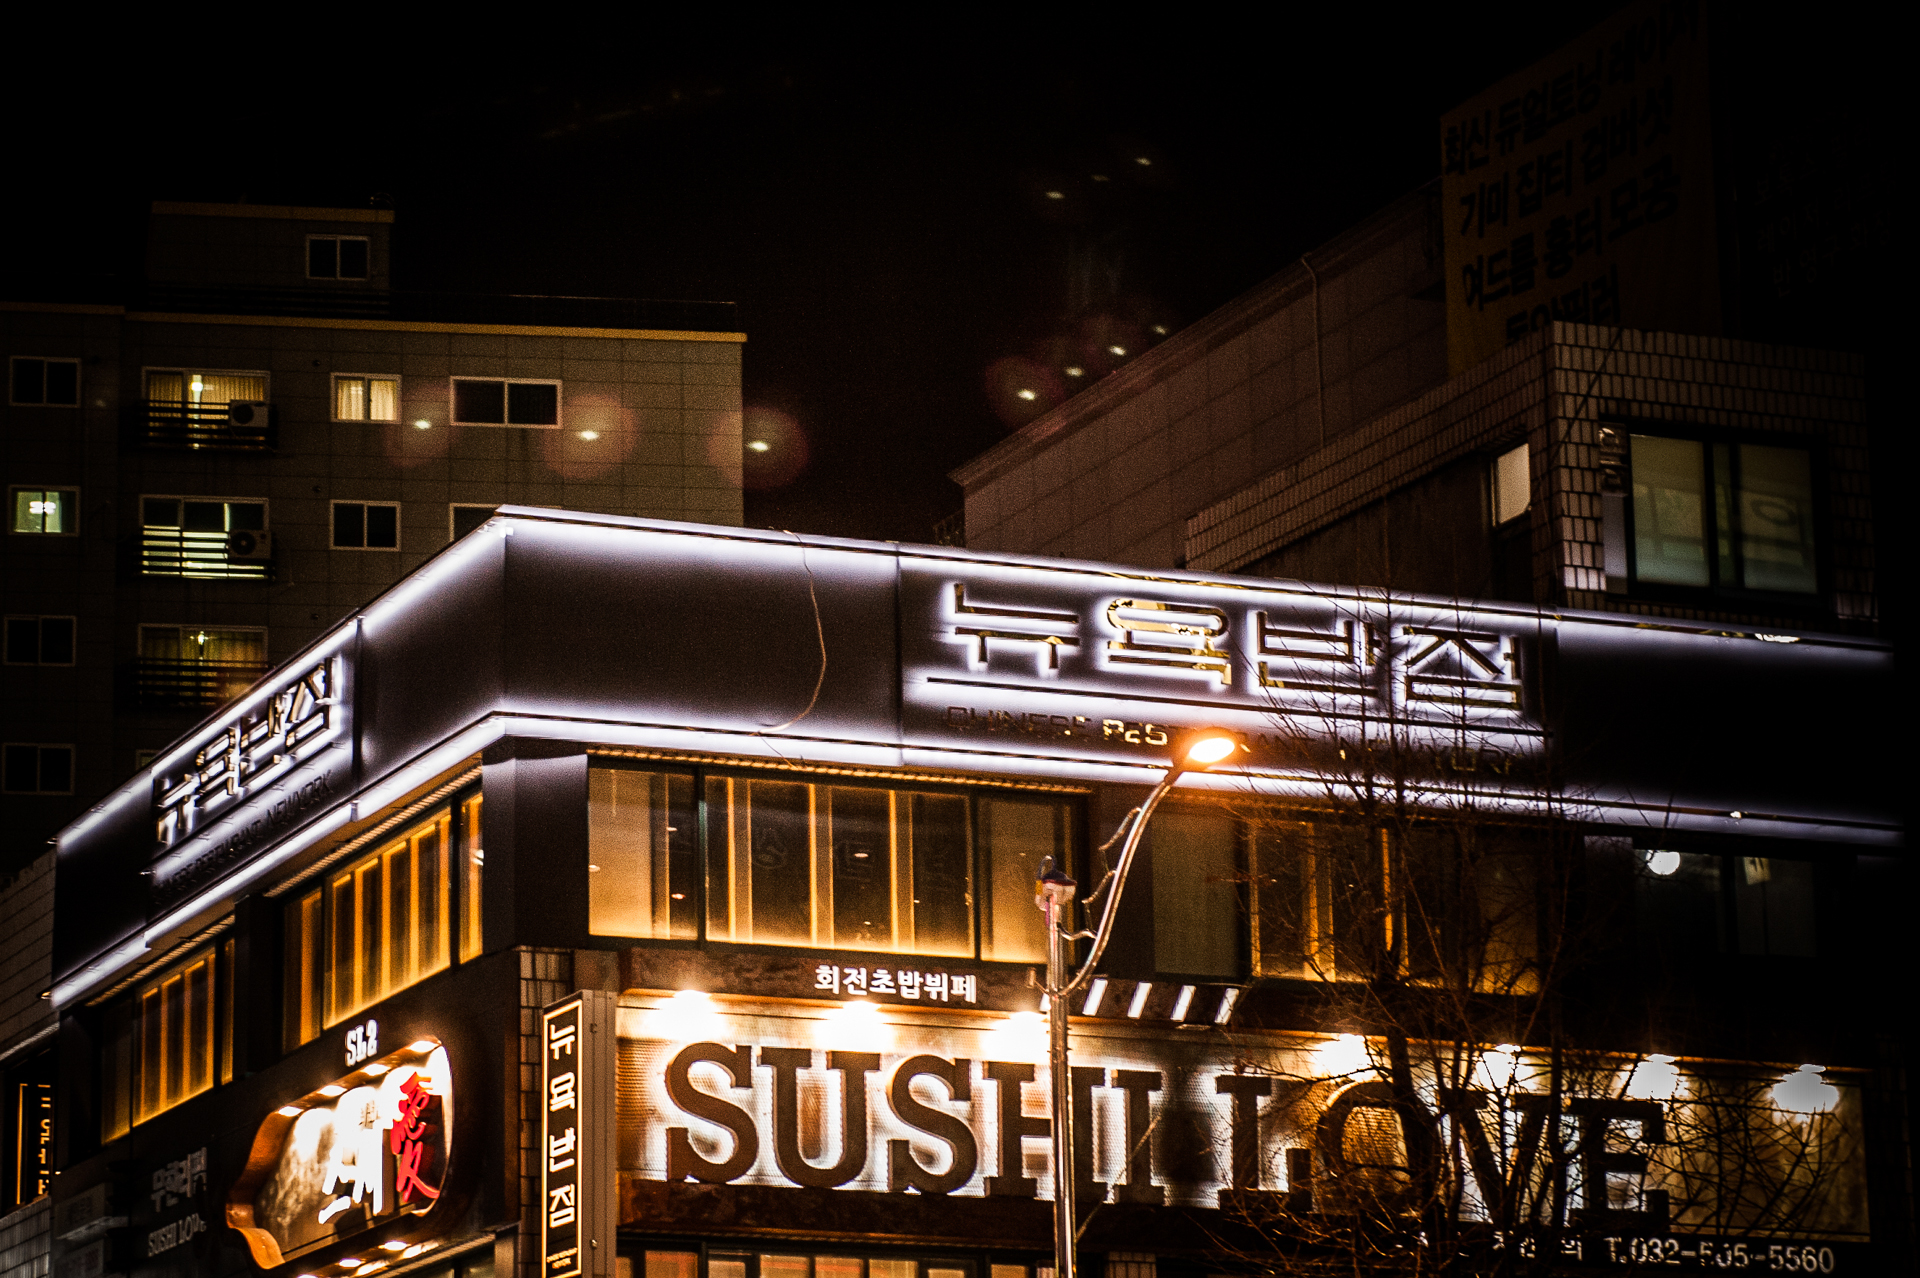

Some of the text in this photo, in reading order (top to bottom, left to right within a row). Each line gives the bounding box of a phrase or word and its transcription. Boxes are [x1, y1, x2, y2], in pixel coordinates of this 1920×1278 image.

[1460, 171, 1509, 238] 기미
[1582, 76, 1672, 185] 검버섯
[1462, 232, 1538, 311] 여드름
[1608, 154, 1680, 241] 모공
[953, 582, 1522, 710] 뉴욕반점
[154, 657, 332, 843] 뉴욕반점
[345, 1019, 378, 1067] SL2
[813, 964, 977, 1003] 회전초밥뷔페
[549, 1023, 576, 1229] 뉴욕반점
[665, 1040, 1163, 1203] SUSHI
